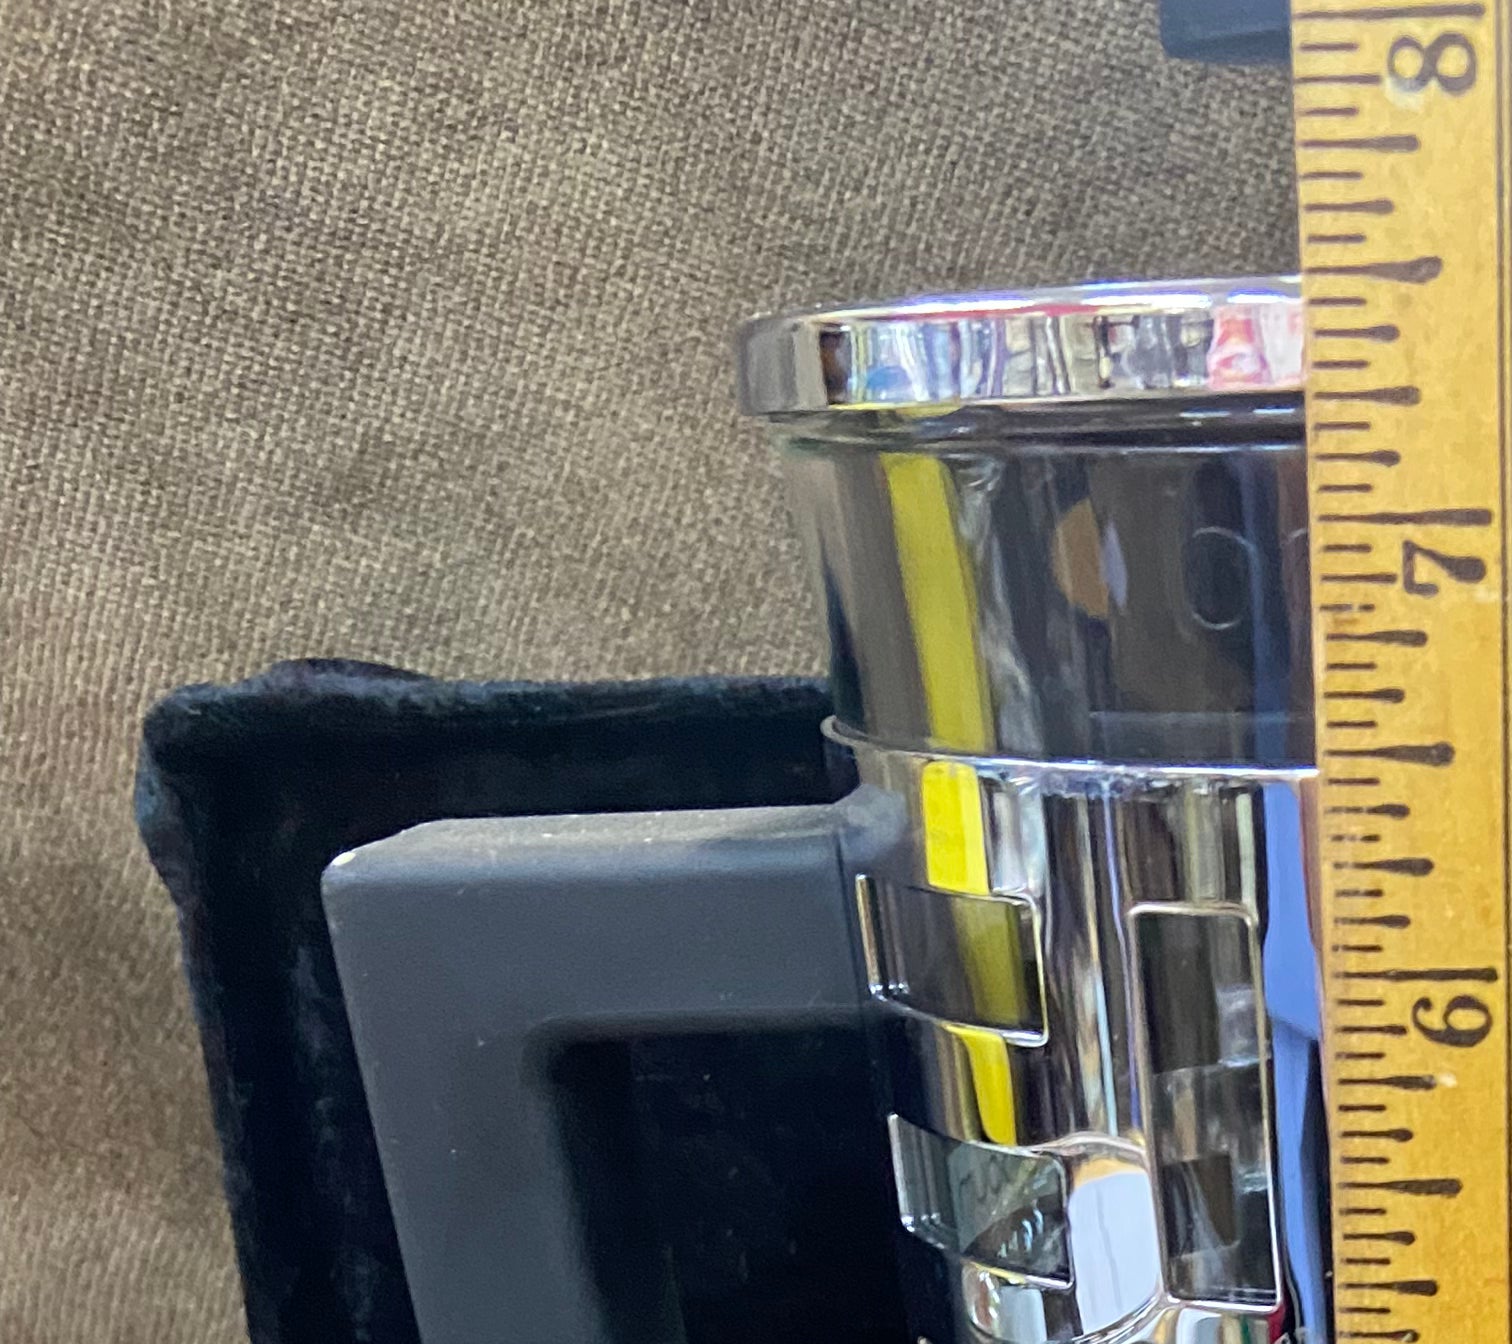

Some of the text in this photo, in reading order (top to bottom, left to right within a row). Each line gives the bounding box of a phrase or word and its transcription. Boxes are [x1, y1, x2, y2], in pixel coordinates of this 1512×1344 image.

[1387, 32, 1477, 96] 8
[1402, 539, 1487, 597] 7
[1411, 994, 1494, 1049] 6
